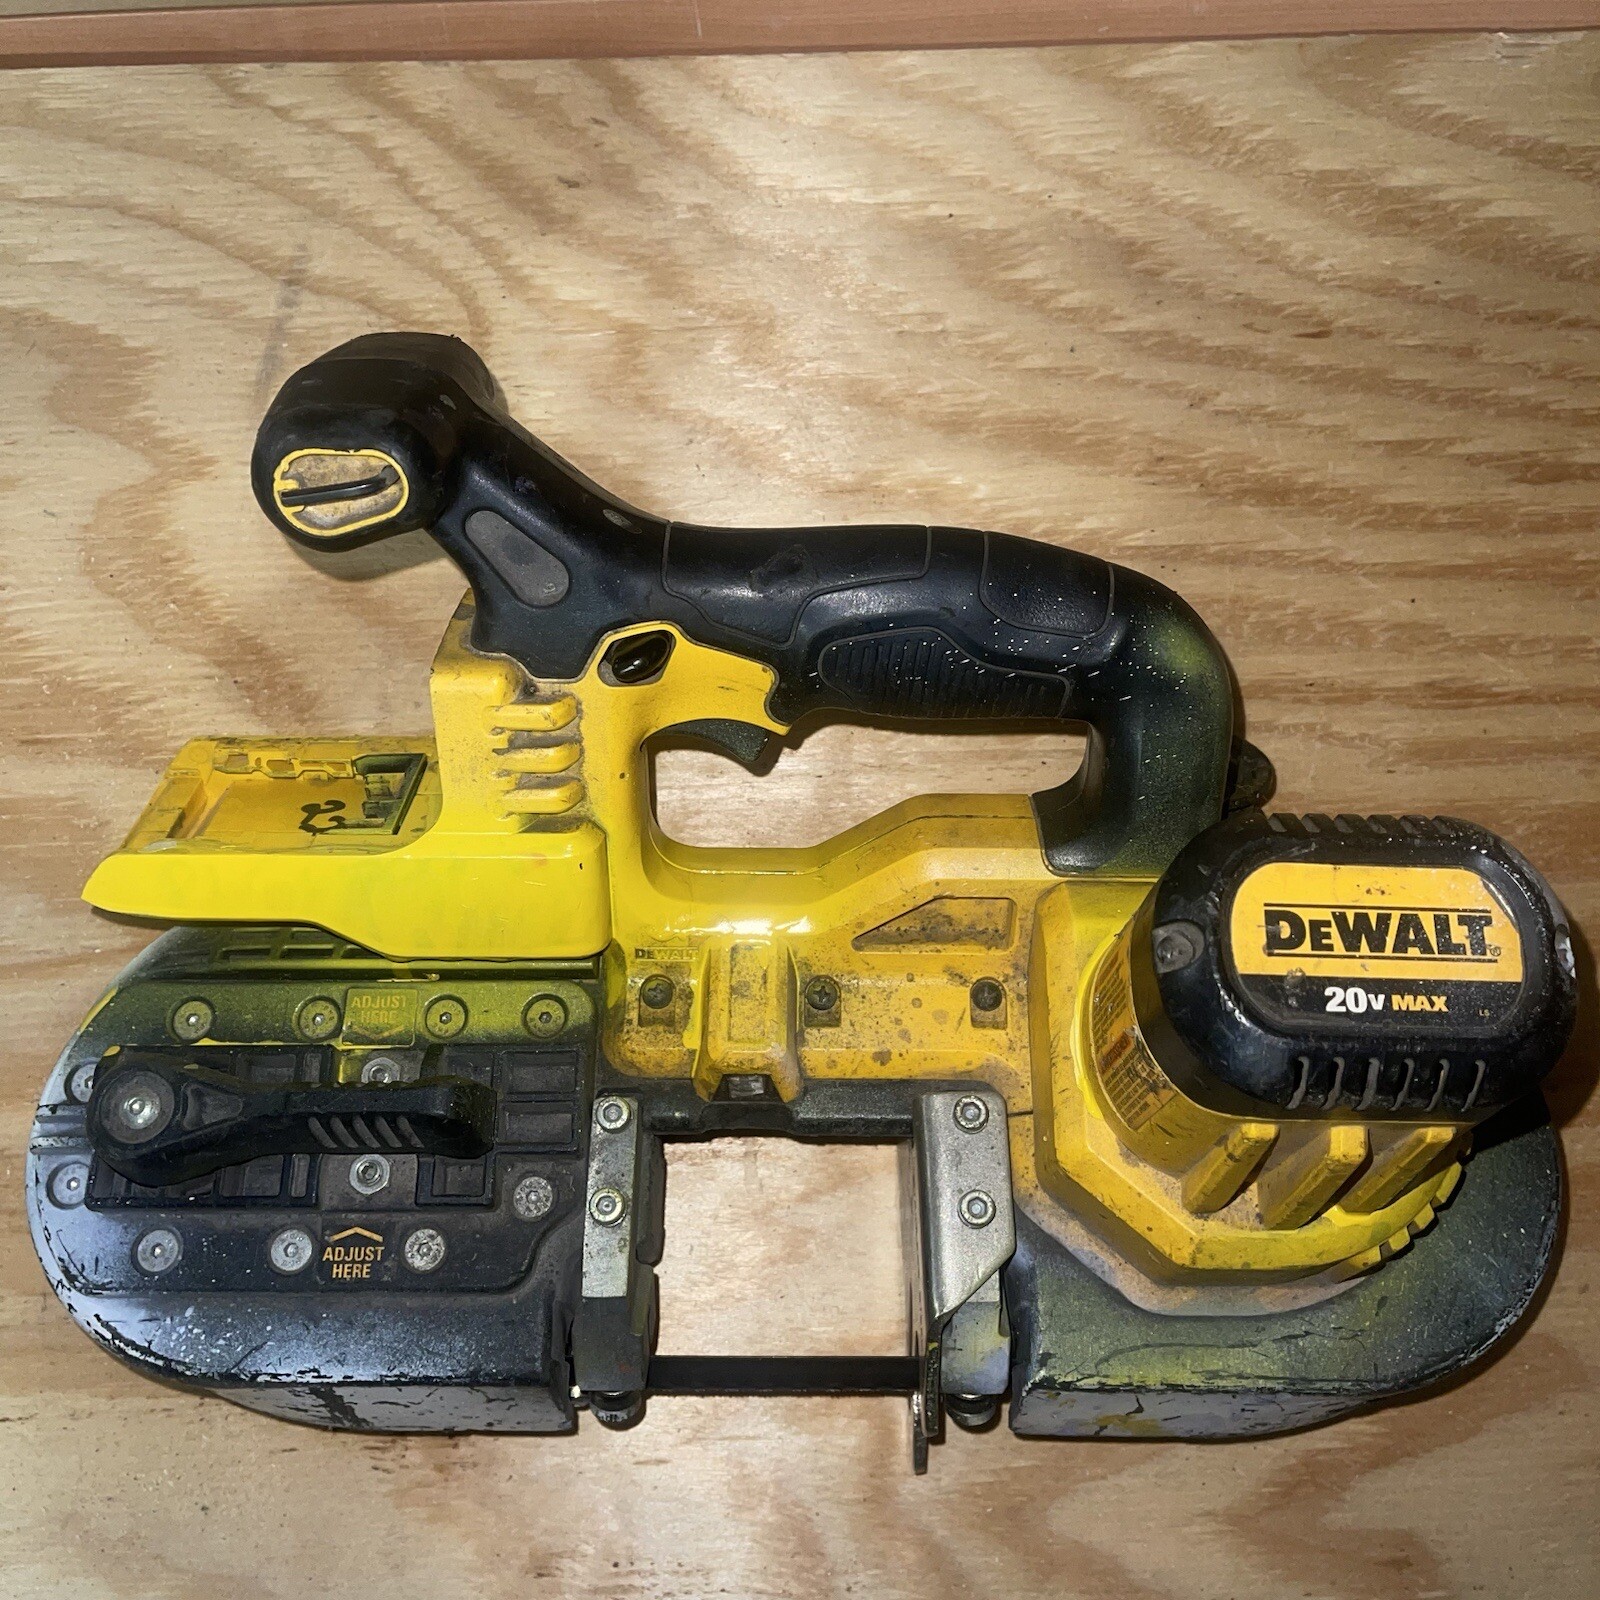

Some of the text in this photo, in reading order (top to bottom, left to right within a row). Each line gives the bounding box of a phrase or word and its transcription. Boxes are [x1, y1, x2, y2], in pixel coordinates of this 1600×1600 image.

[351, 995, 407, 1008] ADJUST
[1391, 994, 1449, 1012] MAX
[322, 1246, 385, 1261] ADJUST
[332, 1263, 372, 1278] HERE
